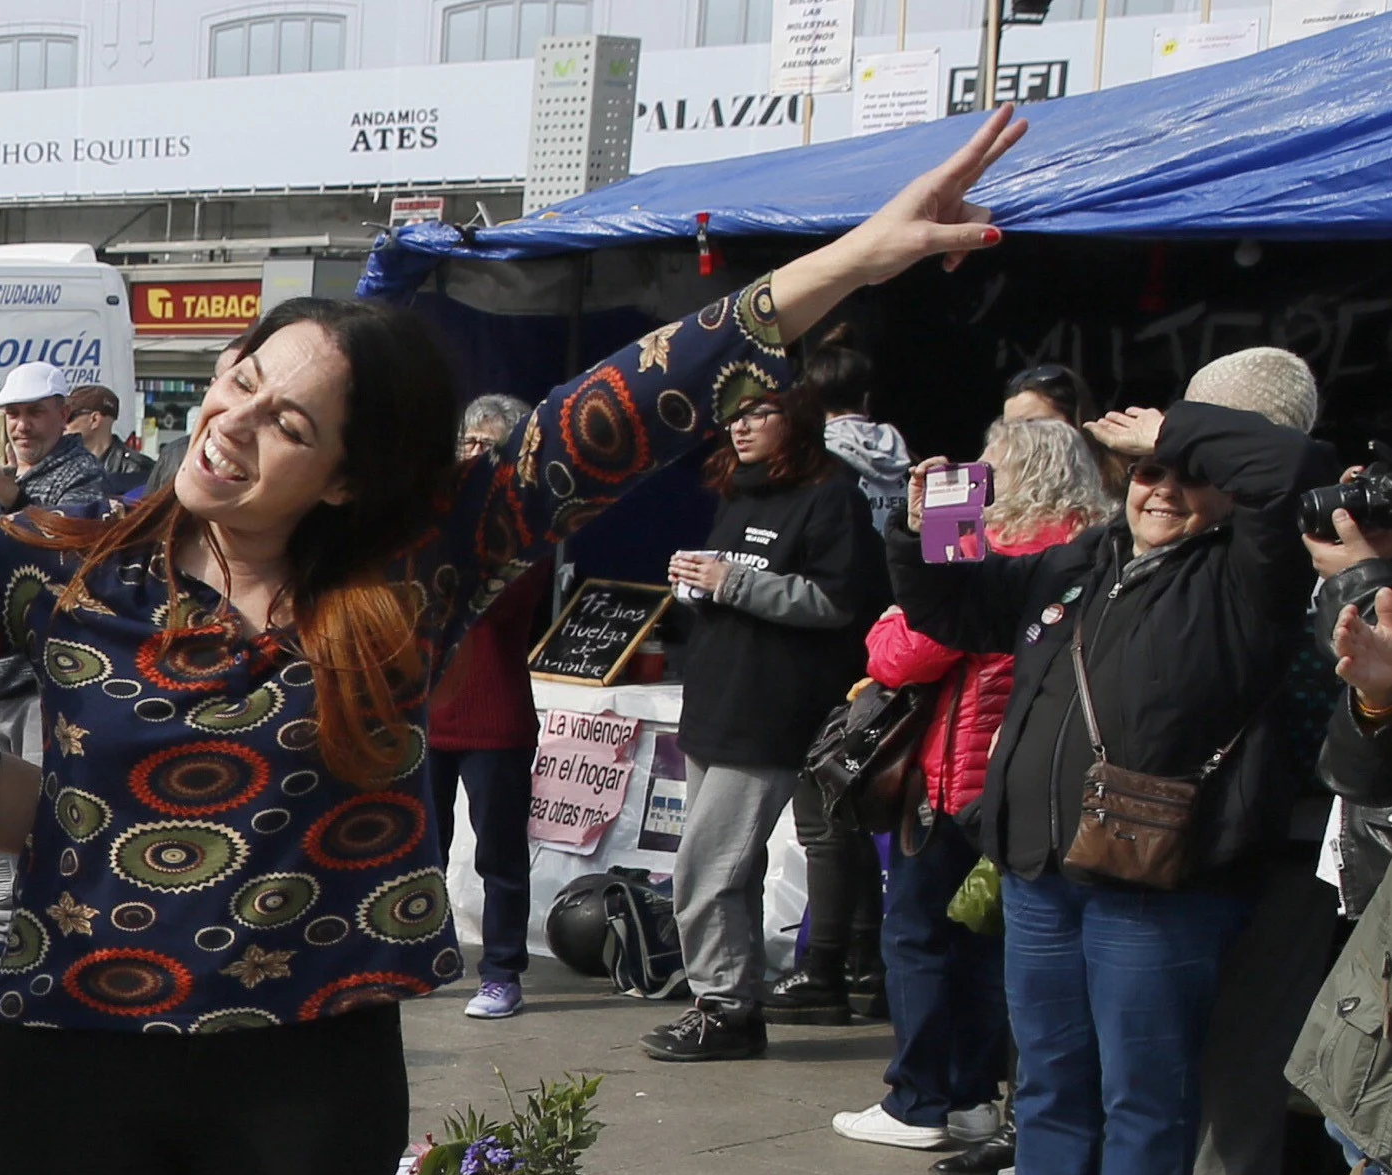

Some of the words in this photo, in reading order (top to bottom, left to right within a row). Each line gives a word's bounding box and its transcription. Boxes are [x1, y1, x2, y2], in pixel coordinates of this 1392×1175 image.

[351, 108, 439, 125] ANDAMIOS
[350, 126, 439, 153] ATES
[548, 711, 567, 736] La
[569, 717, 633, 746] violencia
[536, 756, 558, 775] en
[559, 754, 577, 780] el
[548, 795, 579, 826] otras
